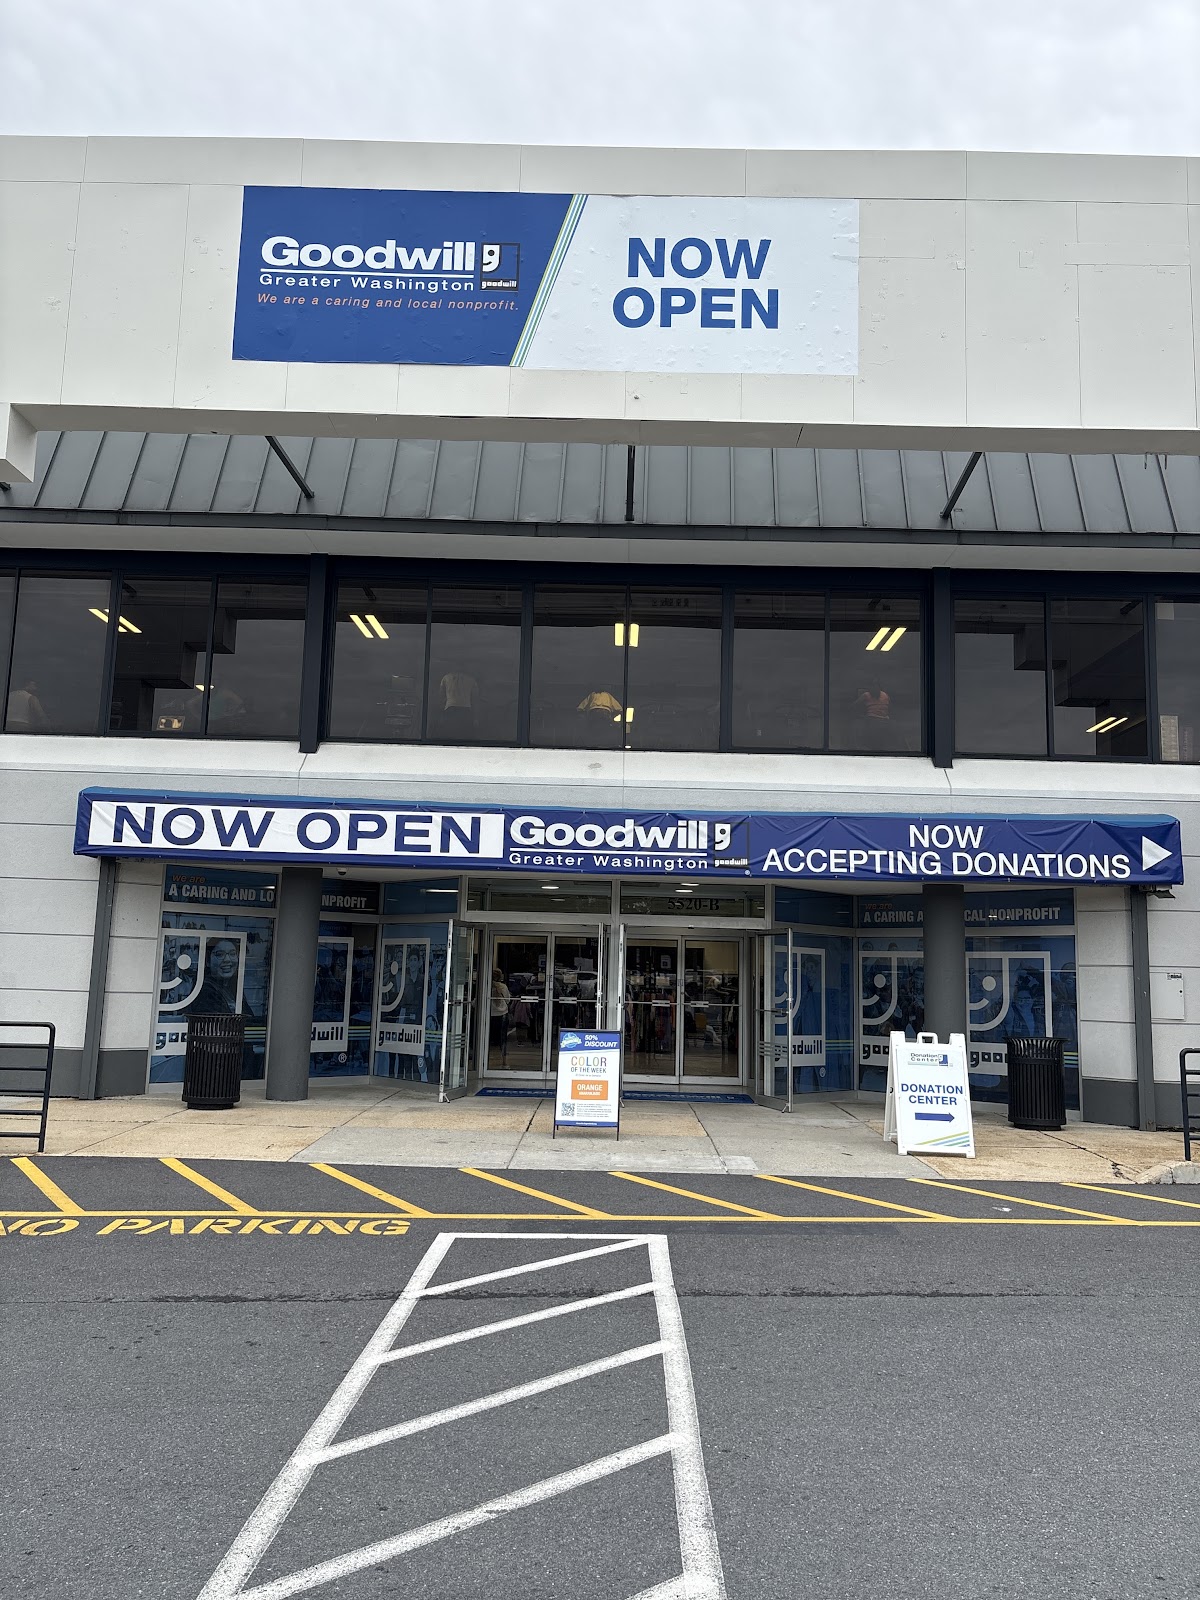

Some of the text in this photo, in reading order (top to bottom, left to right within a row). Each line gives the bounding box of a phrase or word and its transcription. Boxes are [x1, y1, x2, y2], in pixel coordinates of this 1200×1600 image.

[261, 236, 476, 270] Goodwill
[628, 237, 772, 279] NOW
[259, 273, 474, 293] Greater Washington
[481, 280, 517, 289] goodwill
[258, 293, 519, 311] We are a caring and local nonprofit.
[612, 287, 779, 329] OPEN
[113, 802, 482, 855] NOW OPEN
[510, 815, 708, 850] Goodwill
[908, 824, 984, 849] NOW
[508, 852, 708, 871] Greater Washington
[714, 858, 748, 867] goodwill
[762, 848, 1132, 879] ACCEPTING DONATIONS
[172, 874, 206, 884] we are
[168, 884, 178, 896] A
[181, 884, 228, 900] CARING
[231, 887, 257, 901] AND
[321, 894, 367, 909] NPROFIT
[667, 897, 720, 911] 5520-B
[863, 911, 871, 923] A
[874, 910, 914, 923] CARING
[963, 906, 1061, 922] CAL NONPROFIT
[310, 1026, 344, 1041] dwill
[378, 1028, 423, 1047] goodwill
[571, 1056, 607, 1067] COLOR
[576, 1083, 603, 1092] ORANGE
[901, 1083, 964, 1095] DONATION
[908, 1095, 958, 1106] CENTER
[96, 1218, 412, 1236] PARKING
